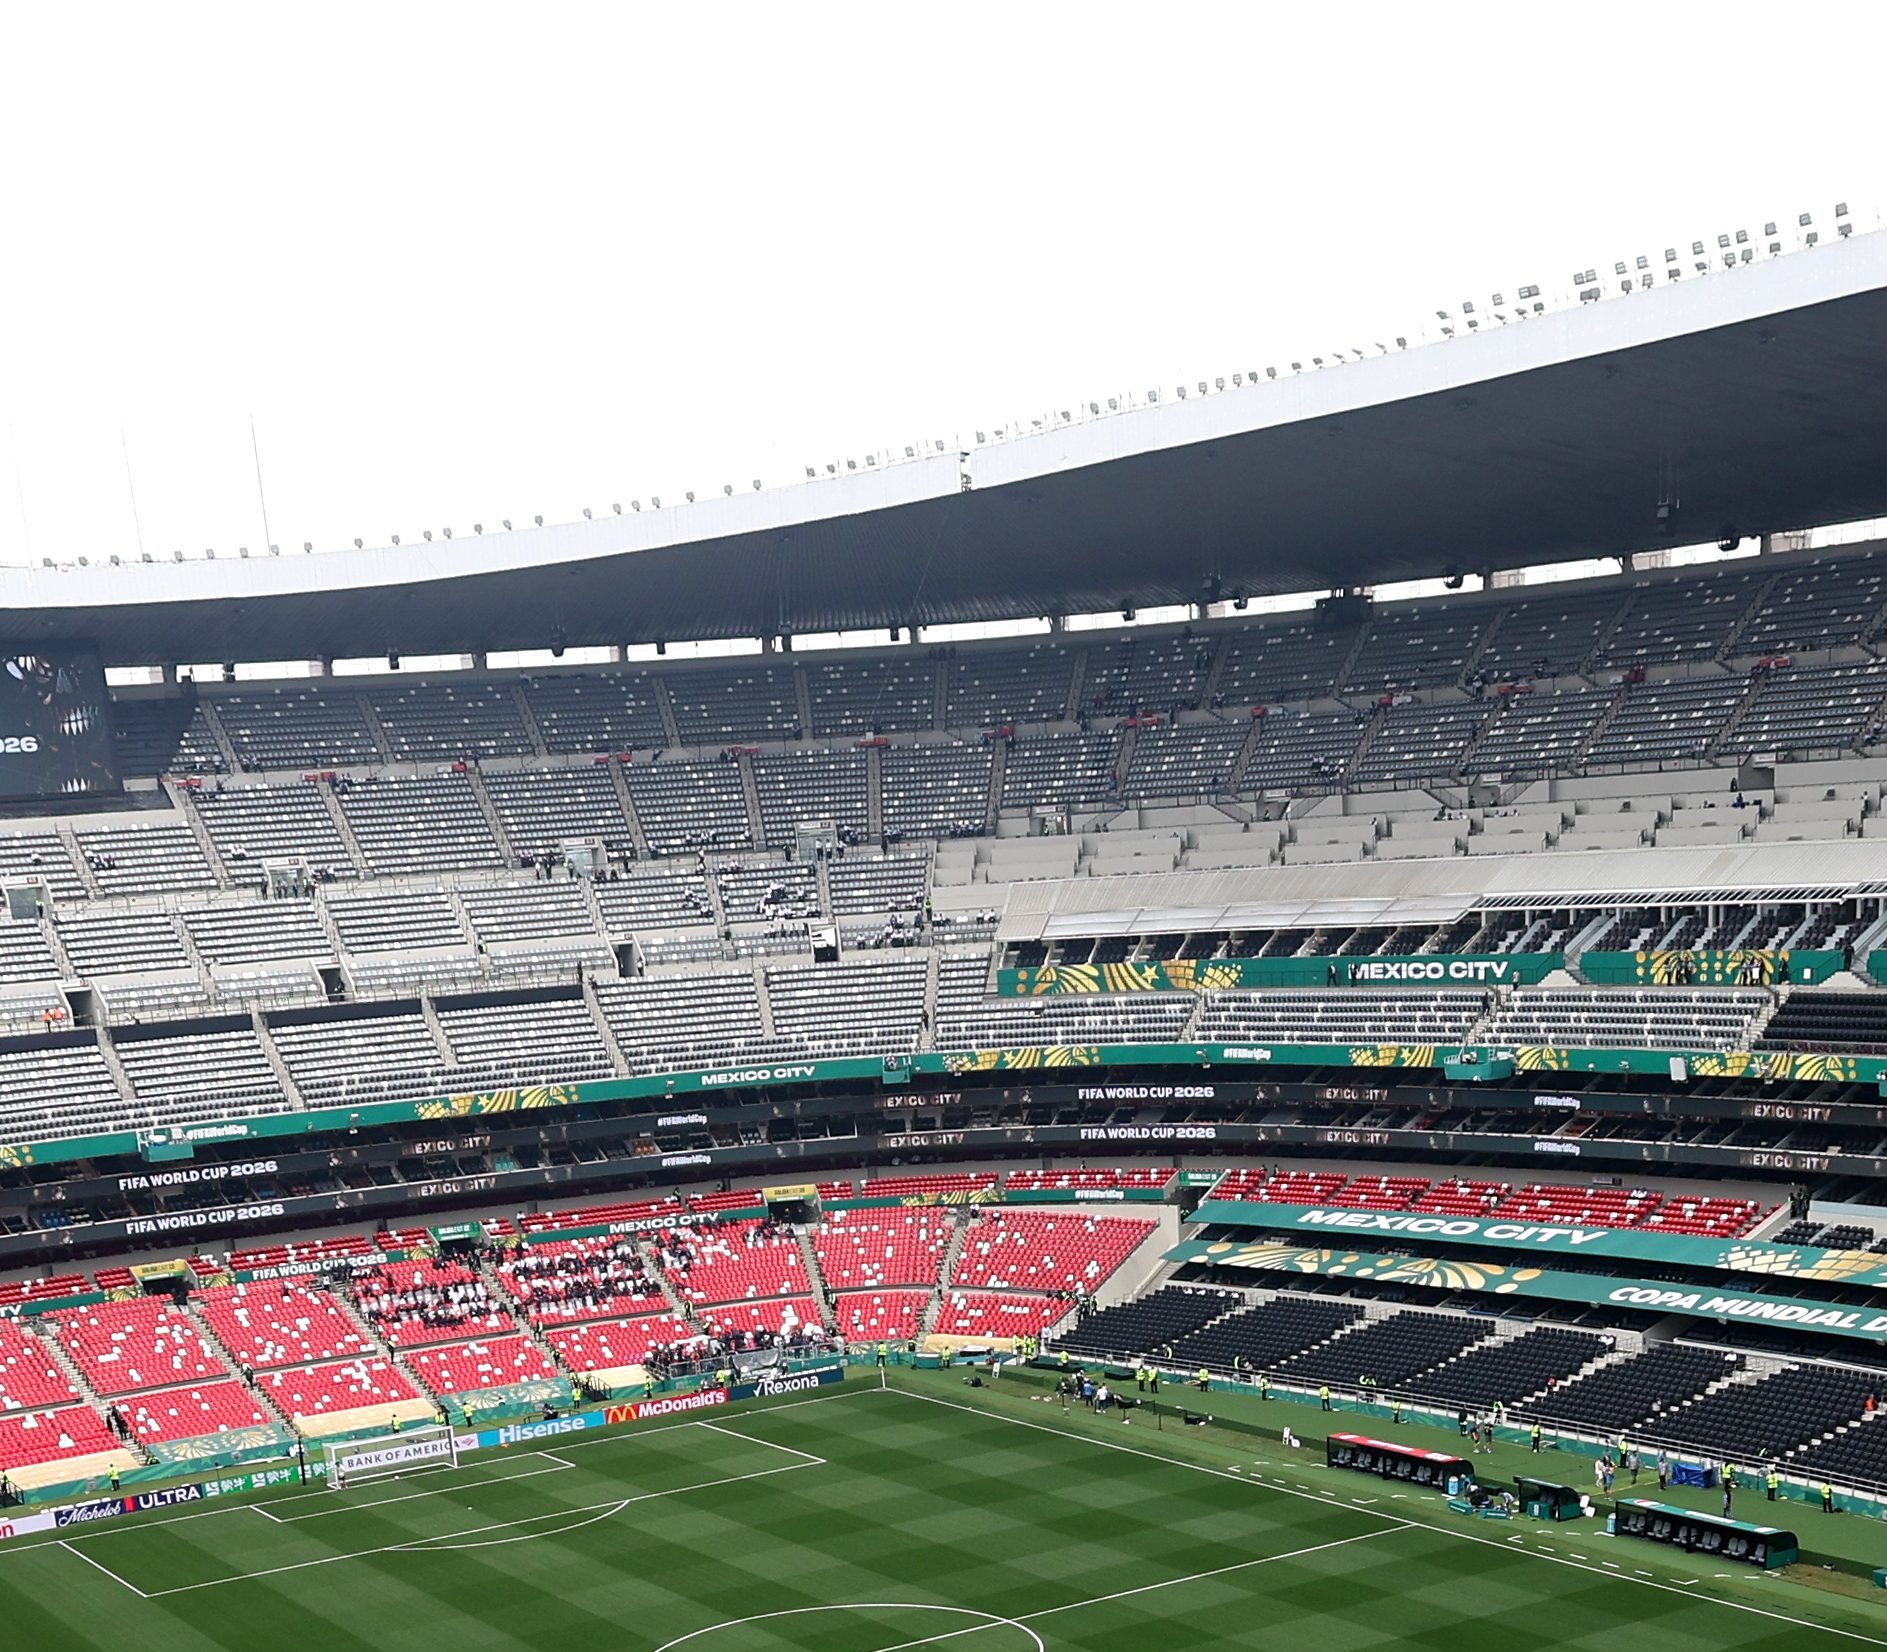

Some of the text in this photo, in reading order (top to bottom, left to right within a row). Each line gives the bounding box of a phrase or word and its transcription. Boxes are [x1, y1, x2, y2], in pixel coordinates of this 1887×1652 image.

[1347, 960, 1508, 981] MEXICO CITY
[701, 1065, 815, 1086] MEXICO CITY
[932, 1093, 962, 1106] CITY
[1078, 1086, 1215, 1100] FIFA WORLD CUP 2026
[935, 1133, 964, 1146] CITY
[1080, 1126, 1217, 1140] FIFA WORLD CUP 2026
[118, 1160, 279, 1191] FIFA WORLD CUP 2026
[126, 1203, 285, 1235] FIFA WORLD CUP 2026
[609, 1212, 719, 1234] MEXICO CITY
[1297, 1210, 1608, 1245] MEXICO CITY
[252, 1266, 278, 1281] FIFA
[279, 1262, 322, 1279] WORLD
[347, 1253, 388, 1268] 2026
[1608, 1286, 1702, 1309] COPA
[1698, 1296, 1860, 1330] MUNDIAL
[763, 1373, 819, 1396] Rexona
[637, 1387, 726, 1419] McDonald's
[498, 1416, 586, 1445] Hisense
[346, 1439, 460, 1469] BANK OF AMERICA
[57, 1485, 201, 1528] Michelob ULTRA
